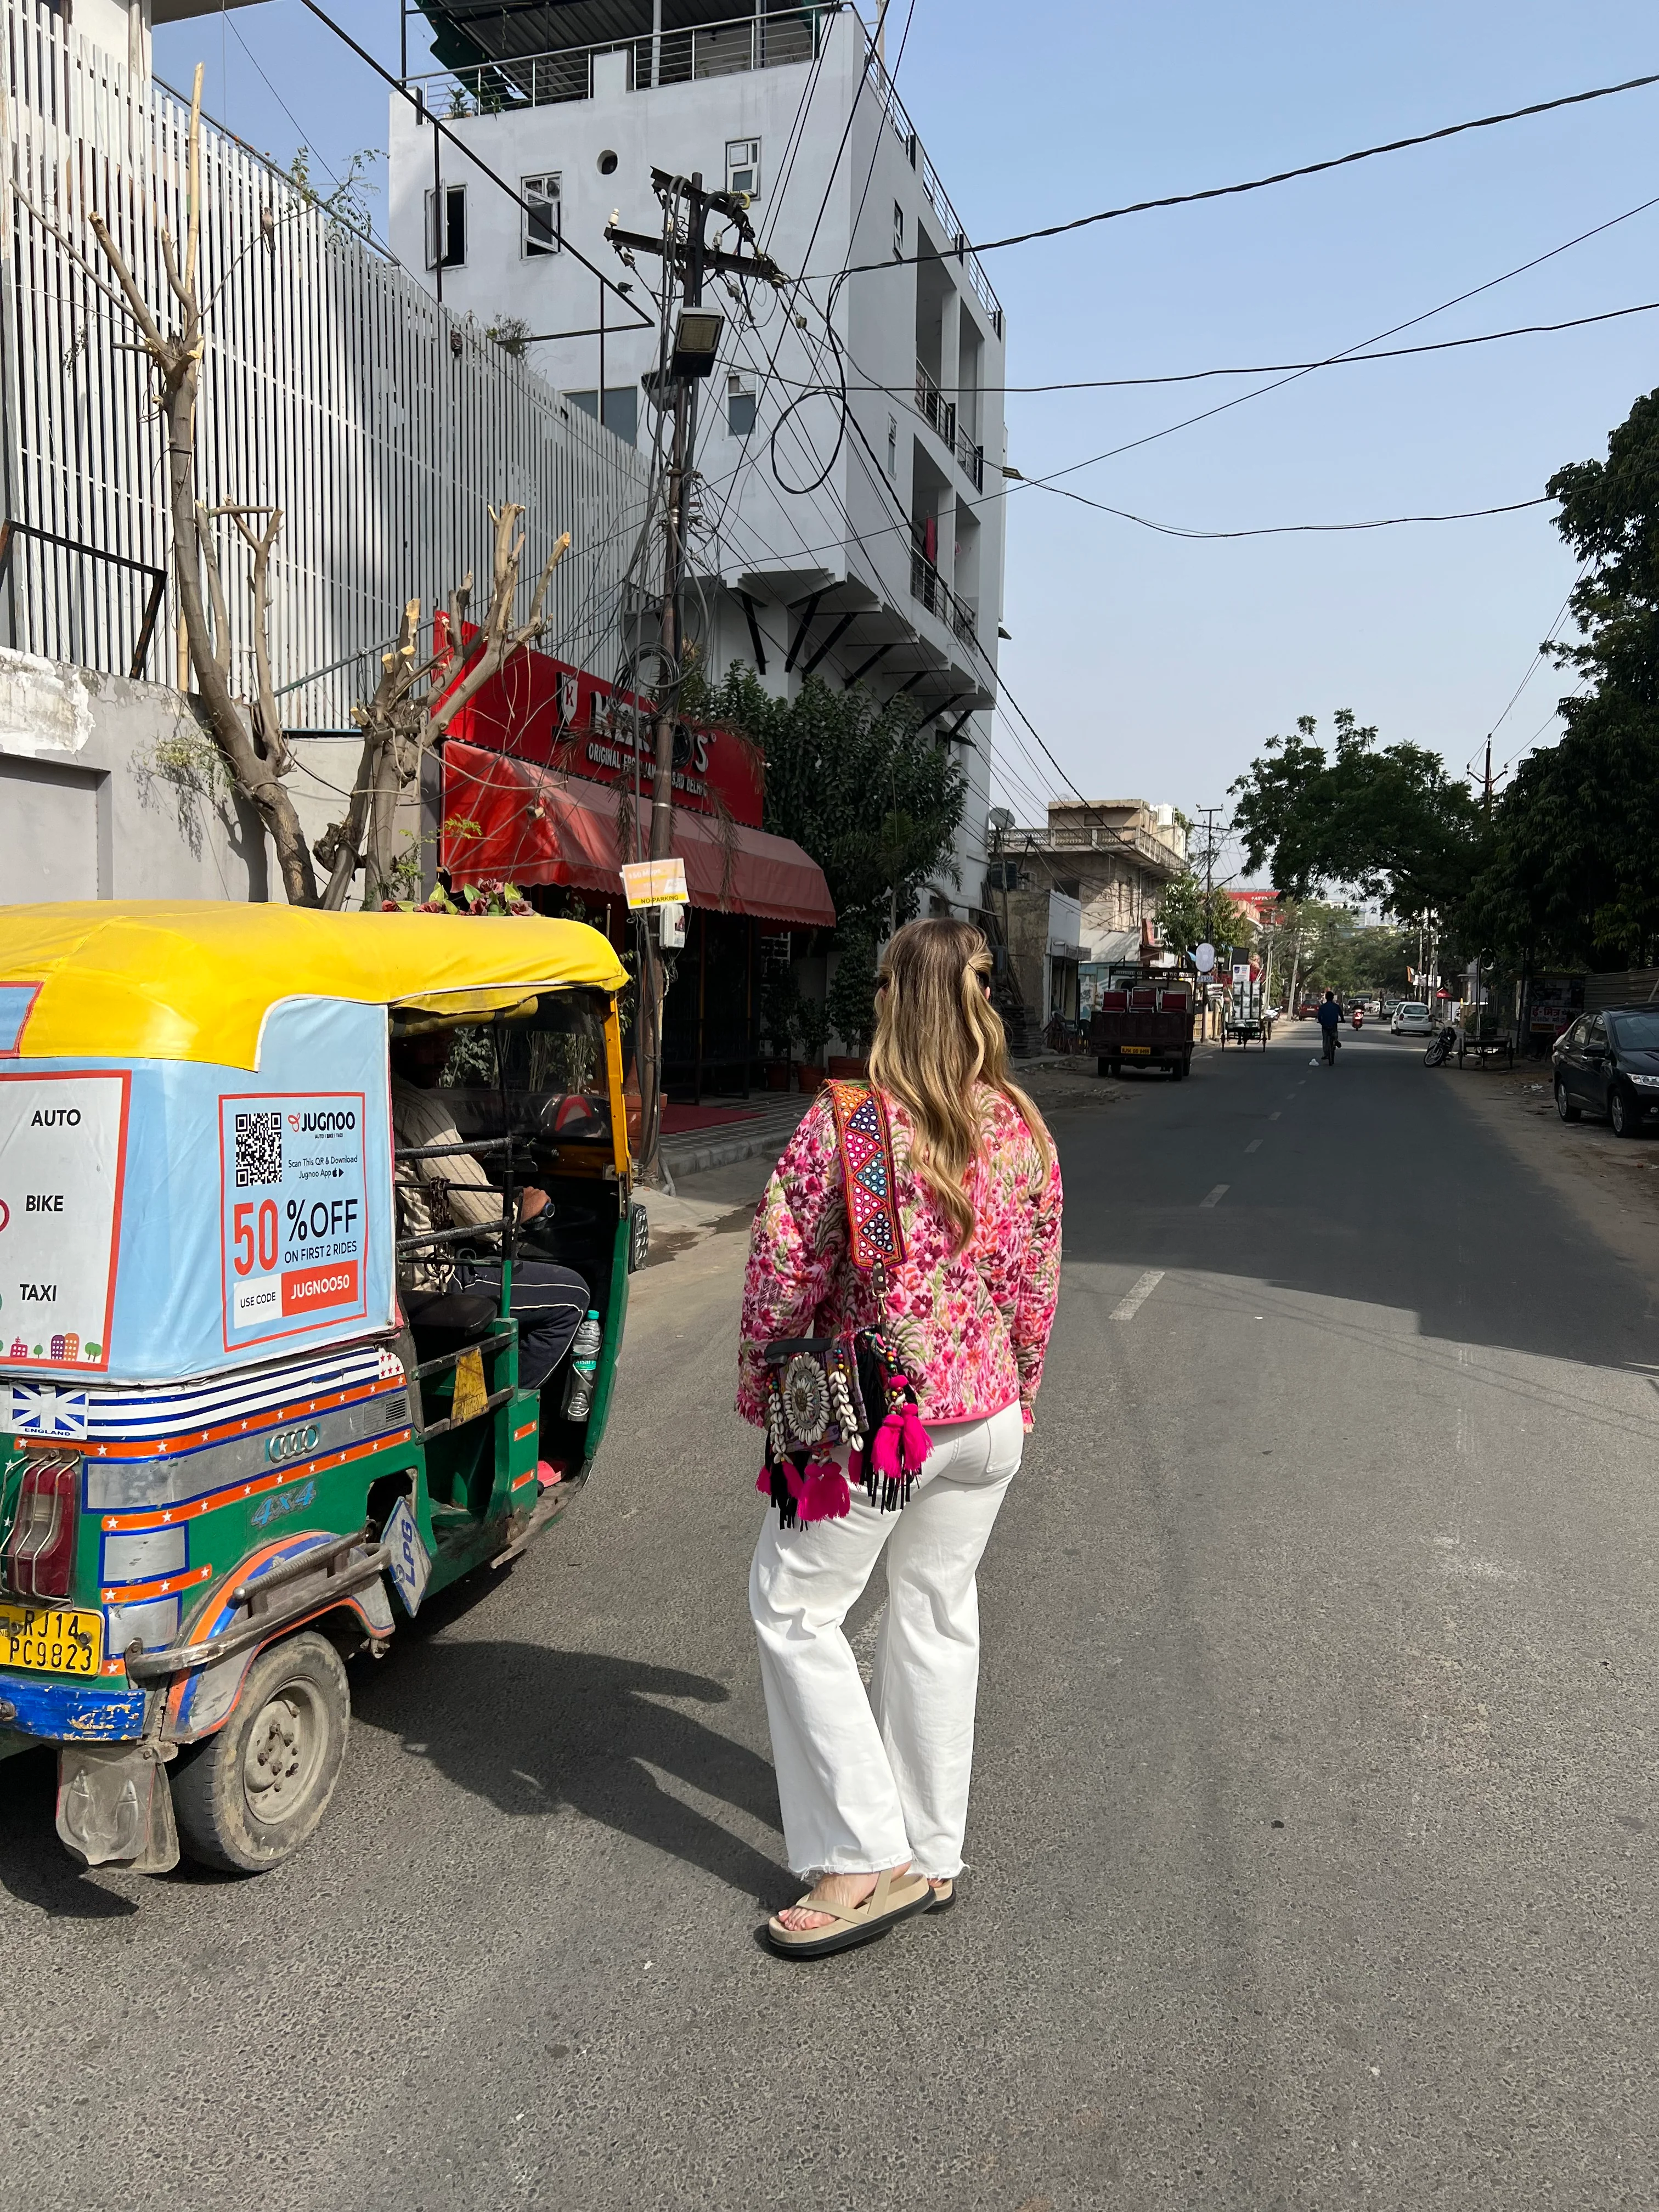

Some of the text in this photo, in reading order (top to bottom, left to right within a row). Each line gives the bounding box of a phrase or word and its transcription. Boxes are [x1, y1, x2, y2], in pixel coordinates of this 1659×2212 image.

[565, 685, 574, 708] K
[589, 742, 621, 769] ORIGINAL
[652, 895, 679, 903] PARKING
[31, 1109, 81, 1126] AUTO
[301, 1111, 356, 1132] JUGNOO
[288, 1154, 358, 1168] Scan This QR & Download
[298, 1169, 331, 1181] Jugnoo App
[26, 1195, 64, 1212] BIKE
[234, 1199, 278, 1276] 50
[284, 1240, 357, 1264] ON FIRST 2 RIDES
[19, 1284, 57, 1302] TAXI
[290, 1274, 350, 1300] JUGNOO50
[240, 1291, 276, 1308] USE CODE
[24, 1427, 71, 1436] ENGLAND
[401, 1519, 416, 1588] LPG
[24, 1610, 79, 1640] RJ14
[10, 1637, 92, 1672] PC9823
